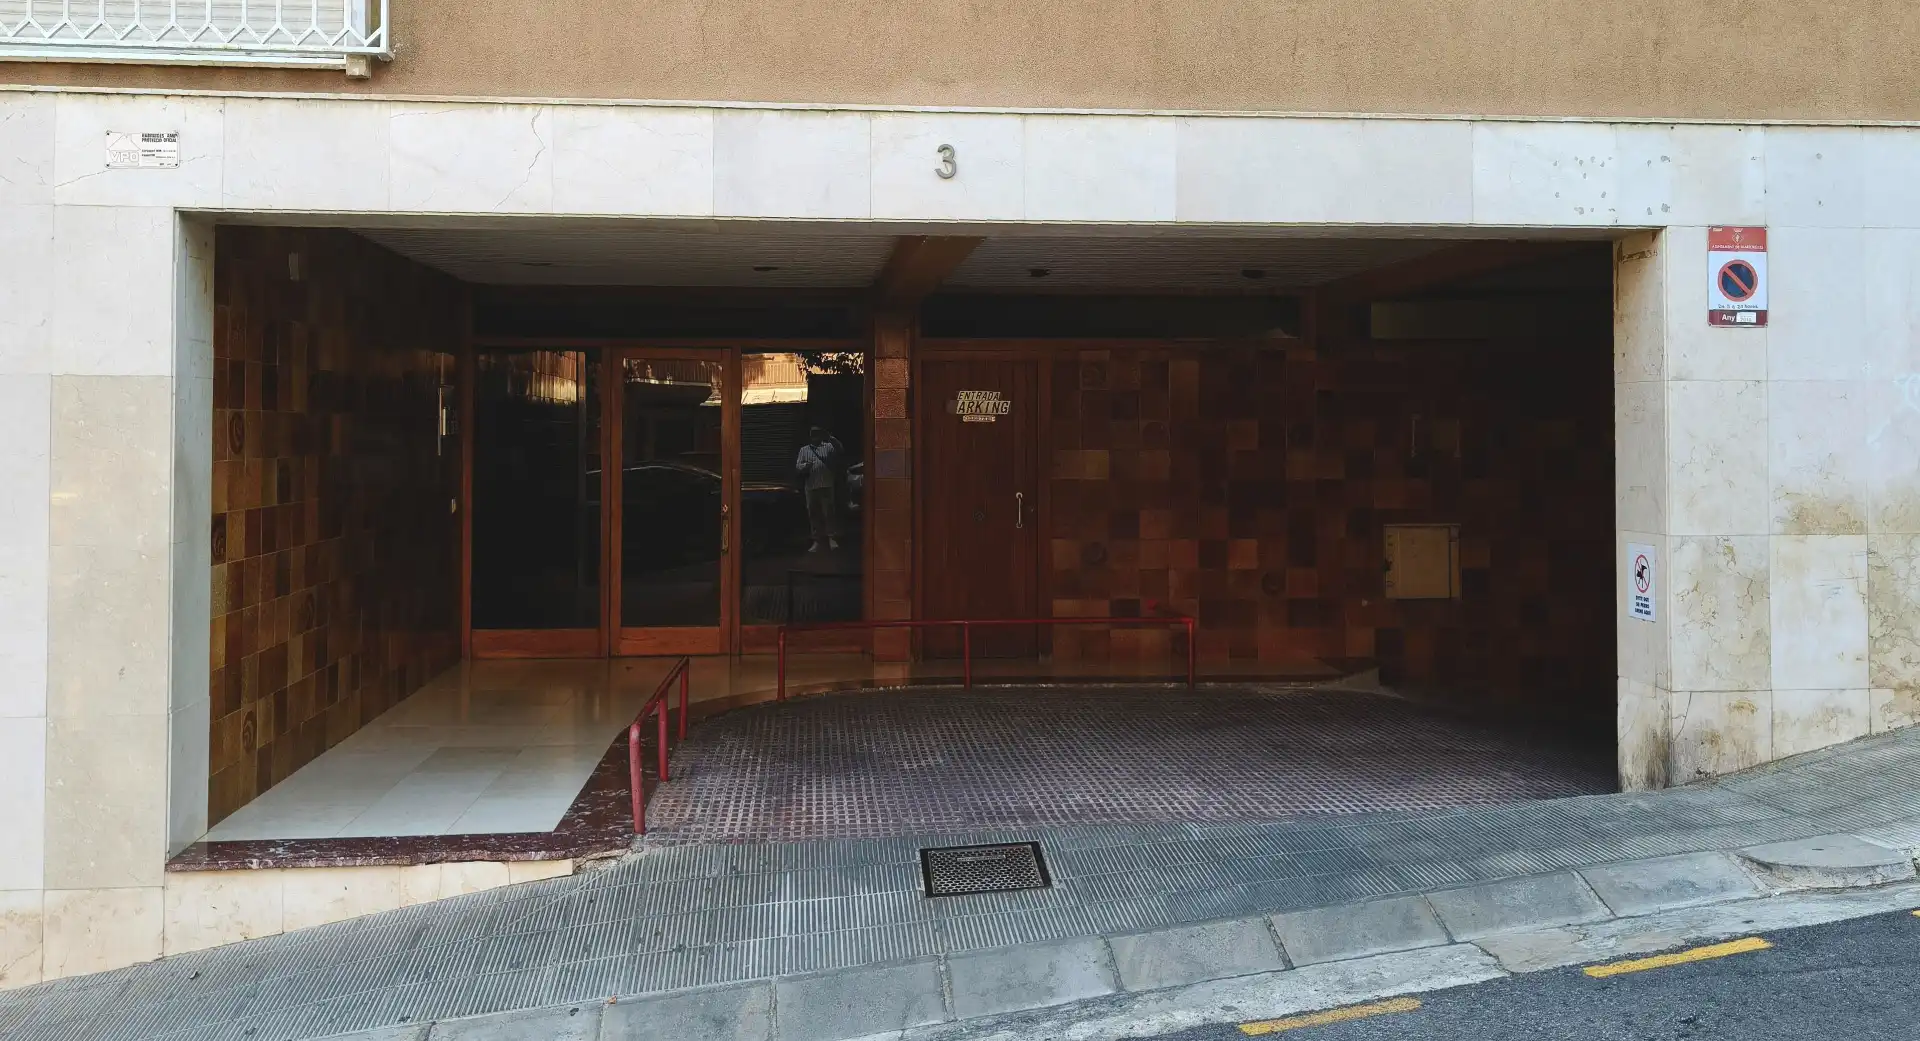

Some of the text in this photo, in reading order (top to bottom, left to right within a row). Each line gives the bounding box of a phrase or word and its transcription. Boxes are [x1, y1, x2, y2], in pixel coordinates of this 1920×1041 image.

[110, 151, 140, 163] VPO
[934, 143, 957, 180] 3
[1722, 314, 1735, 322] Any
[958, 391, 1001, 400] ENTRADA
[957, 401, 1009, 414] ARKING
